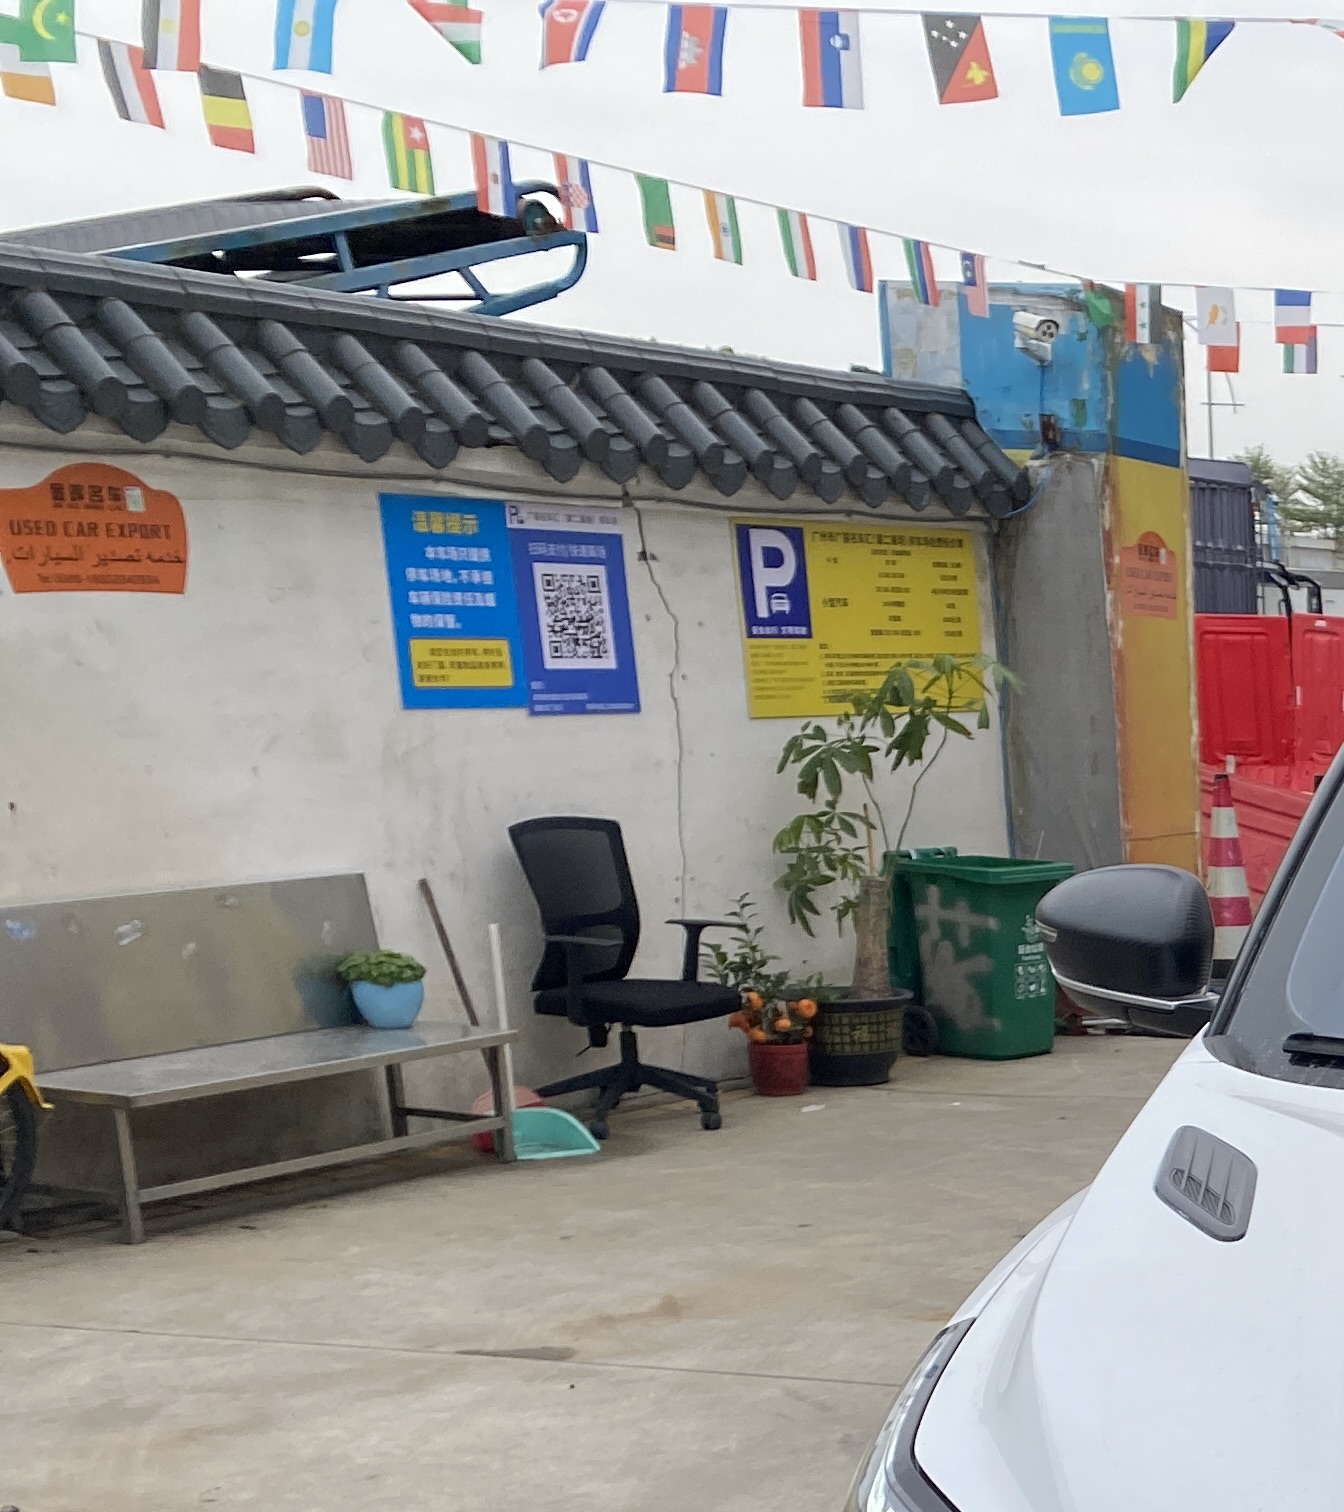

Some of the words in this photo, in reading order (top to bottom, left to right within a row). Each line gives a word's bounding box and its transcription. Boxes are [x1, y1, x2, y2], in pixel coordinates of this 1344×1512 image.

[9, 520, 57, 536] USED
[63, 521, 99, 537] CAR
[105, 522, 172, 540] EXPORT
[748, 528, 796, 618] P
